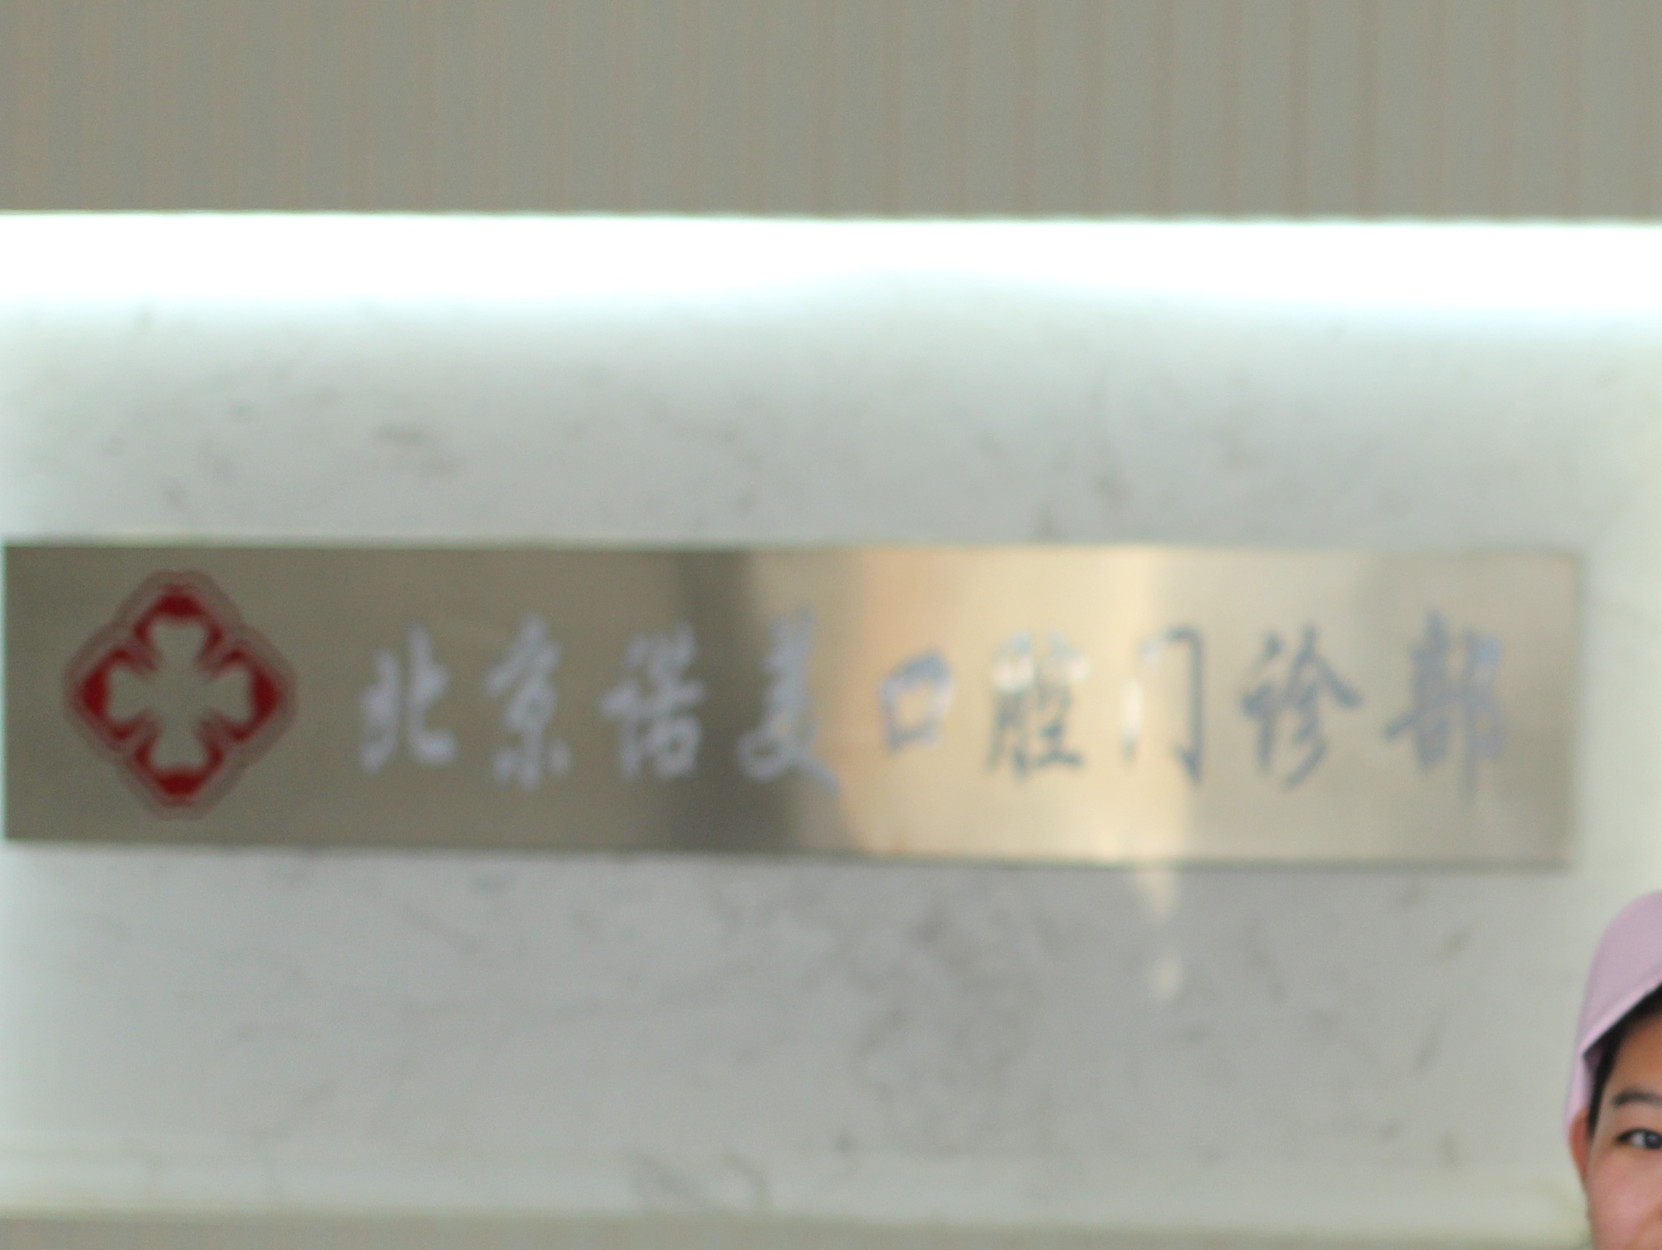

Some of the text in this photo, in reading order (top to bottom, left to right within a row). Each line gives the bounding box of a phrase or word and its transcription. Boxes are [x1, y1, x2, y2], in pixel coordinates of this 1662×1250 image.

[357, 607, 1506, 805] 北京诺美口腔门诊部
